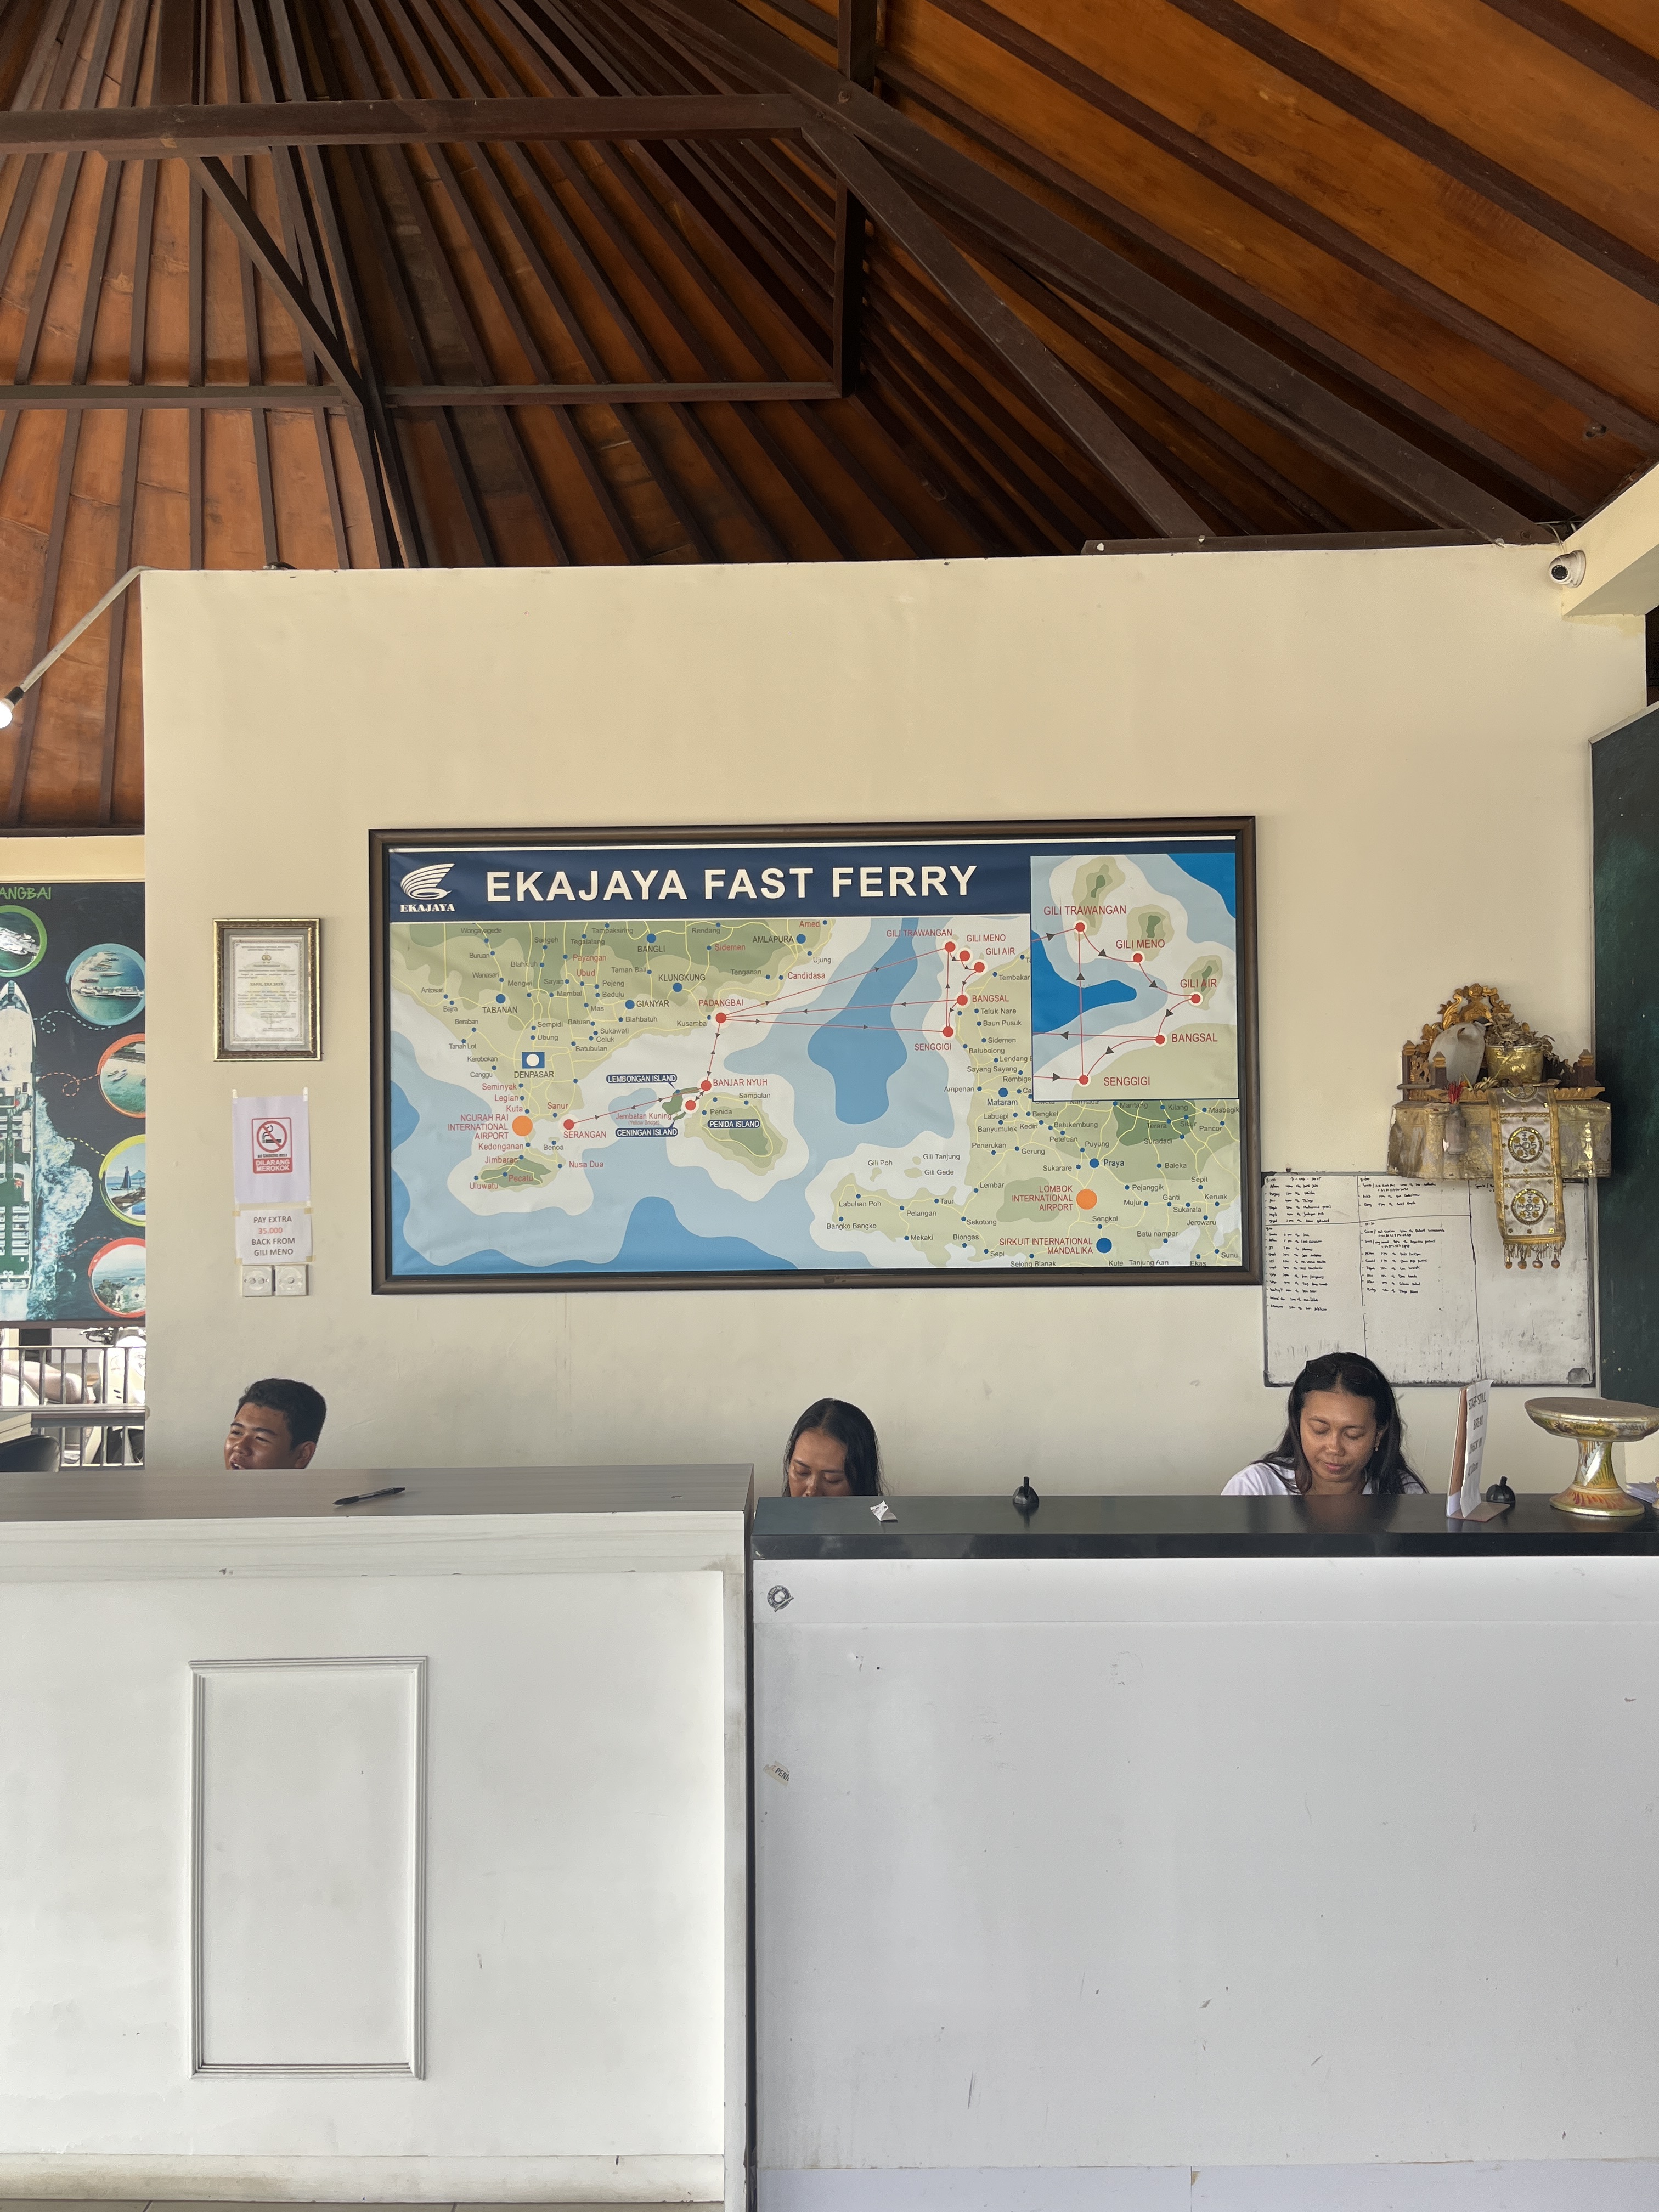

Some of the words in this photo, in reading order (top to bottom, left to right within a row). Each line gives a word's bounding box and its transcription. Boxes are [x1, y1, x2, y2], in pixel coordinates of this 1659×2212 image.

[487, 870, 687, 901] EKAJAYA
[704, 868, 814, 899] FAST
[833, 866, 978, 898] FERRY
[400, 904, 455, 912] EKAJAYA
[1044, 907, 1062, 915] GILI
[1064, 905, 1126, 915] TRAWANGAN
[1116, 940, 1134, 949] GILI
[1137, 939, 1165, 948] MENO
[1180, 980, 1198, 988] GILI
[1200, 979, 1217, 988] AIR
[1172, 1033, 1217, 1042] BANGSAL
[1104, 1077, 1150, 1086] SENGGIGI
[1473, 1415, 1483, 1430] BREAK
